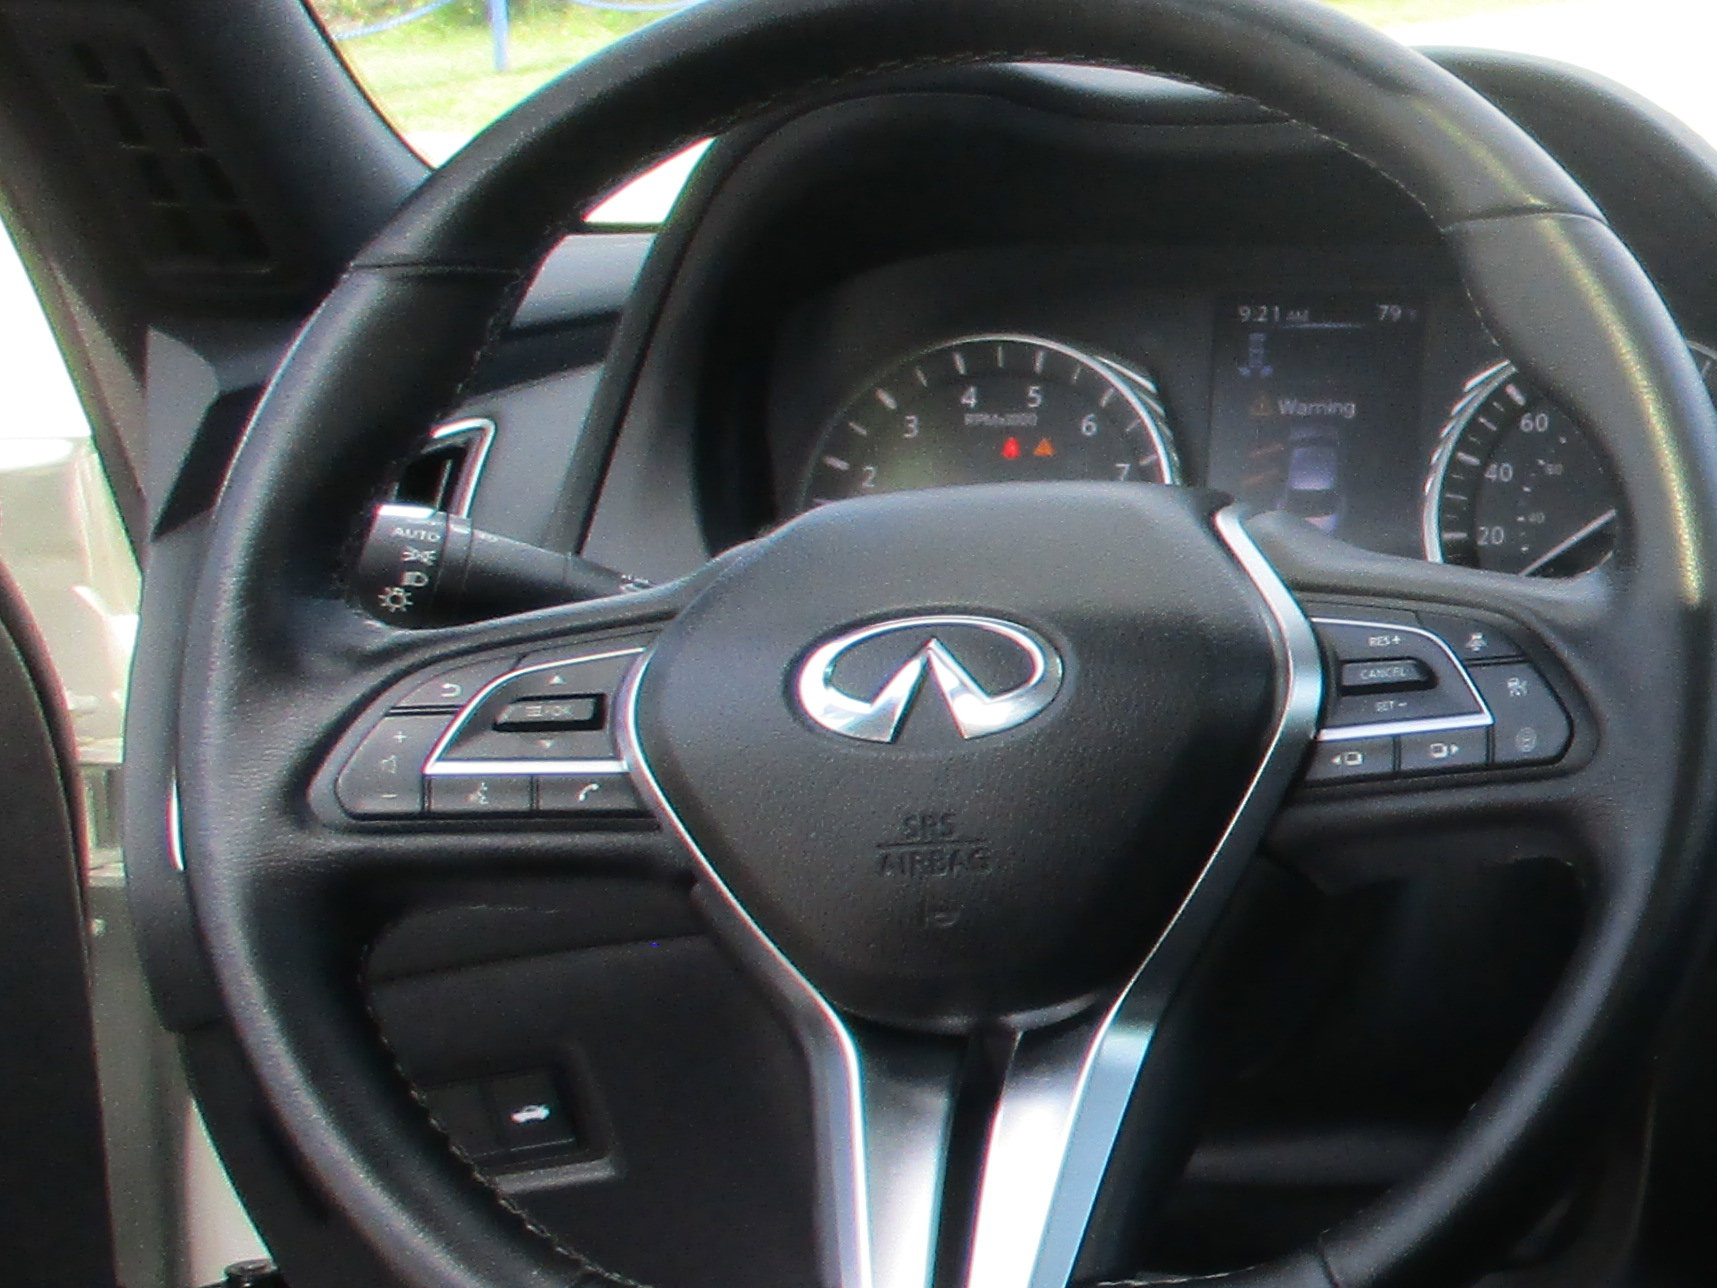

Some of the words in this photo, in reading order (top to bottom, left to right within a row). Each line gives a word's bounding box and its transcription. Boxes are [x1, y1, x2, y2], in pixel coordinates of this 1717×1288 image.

[960, 385, 977, 409] 4
[1027, 384, 1043, 408] 5
[1278, 397, 1356, 419] Warning
[903, 414, 920, 439] 3
[1080, 413, 1097, 437] 6
[1519, 412, 1549, 433] 60
[861, 465, 877, 489] 2
[1115, 463, 1131, 482] 7
[1484, 463, 1514, 483] 40
[391, 526, 441, 543] AUTO
[1477, 525, 1505, 546] 20
